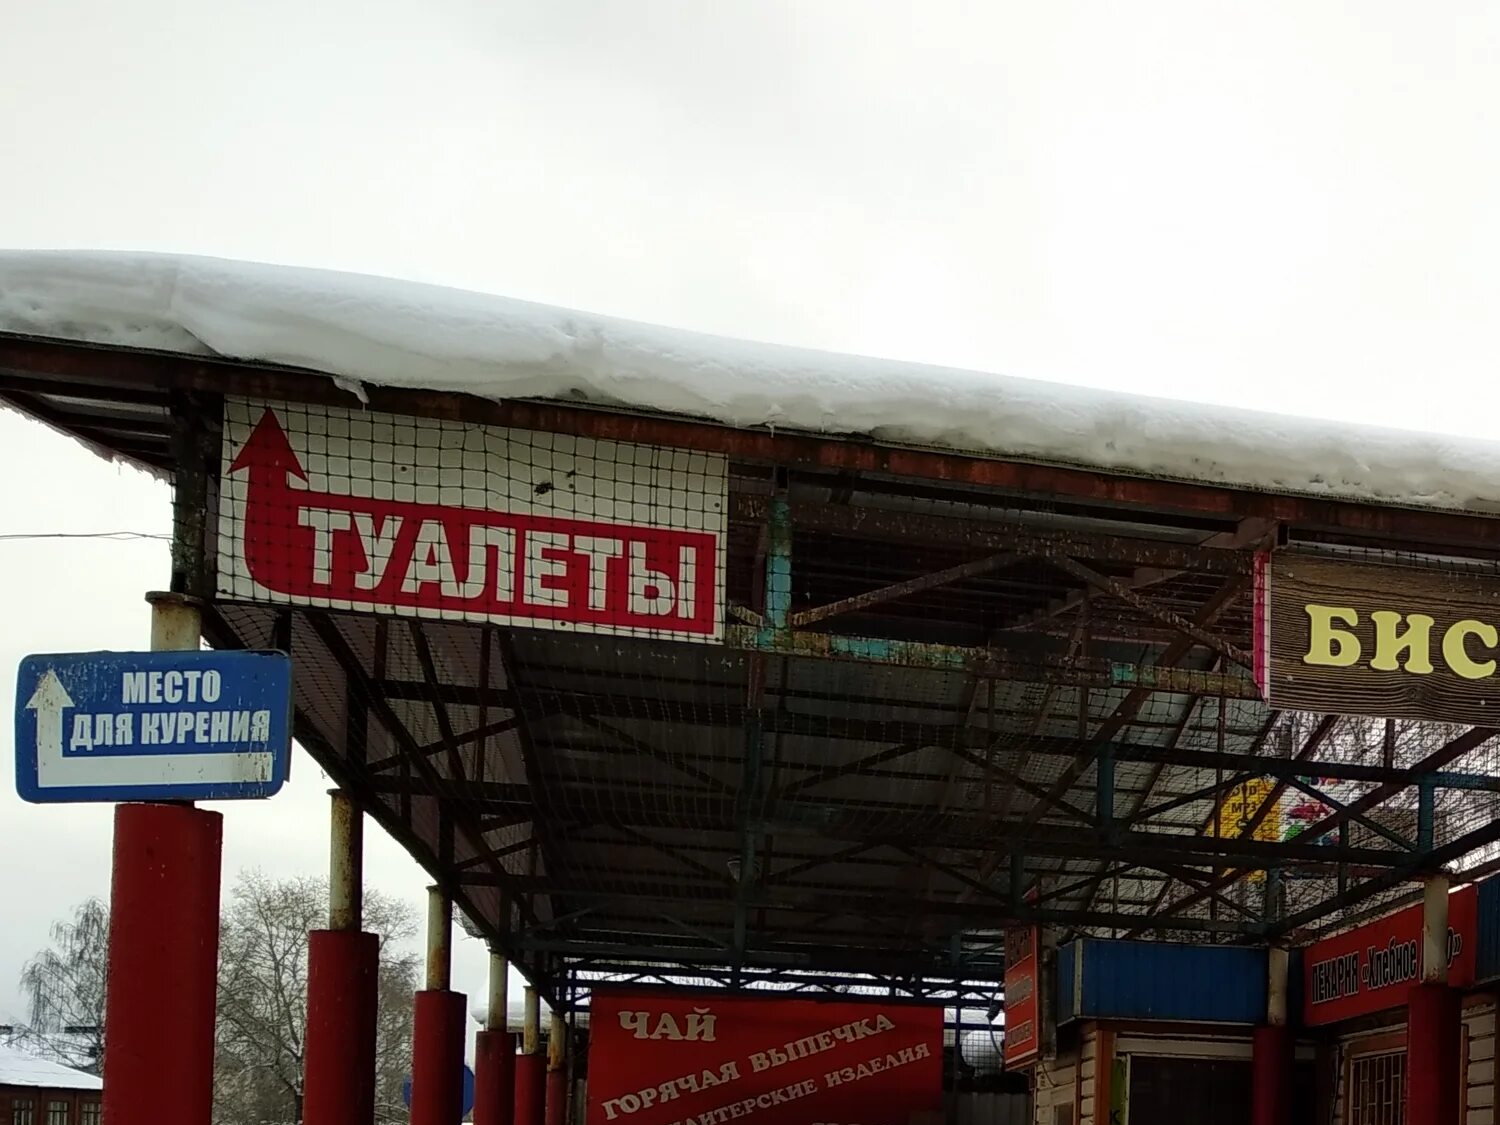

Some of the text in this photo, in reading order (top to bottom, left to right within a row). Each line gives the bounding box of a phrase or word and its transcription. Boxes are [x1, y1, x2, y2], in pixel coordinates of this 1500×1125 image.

[297, 505, 697, 621] ТУАЛЕТЫ
[122, 669, 222, 706] МЕСТО
[70, 709, 271, 750] ДЛЯ КУРЕНИЯ
[1312, 950, 1359, 1005] ПЕКАРНЯ
[617, 1006, 718, 1042] ЧАЙ
[601, 1013, 896, 1121] ГОРЯЧАЯ ВЫПЕЧКА
[823, 1043, 931, 1089] ИЗДЕЛИЯ
